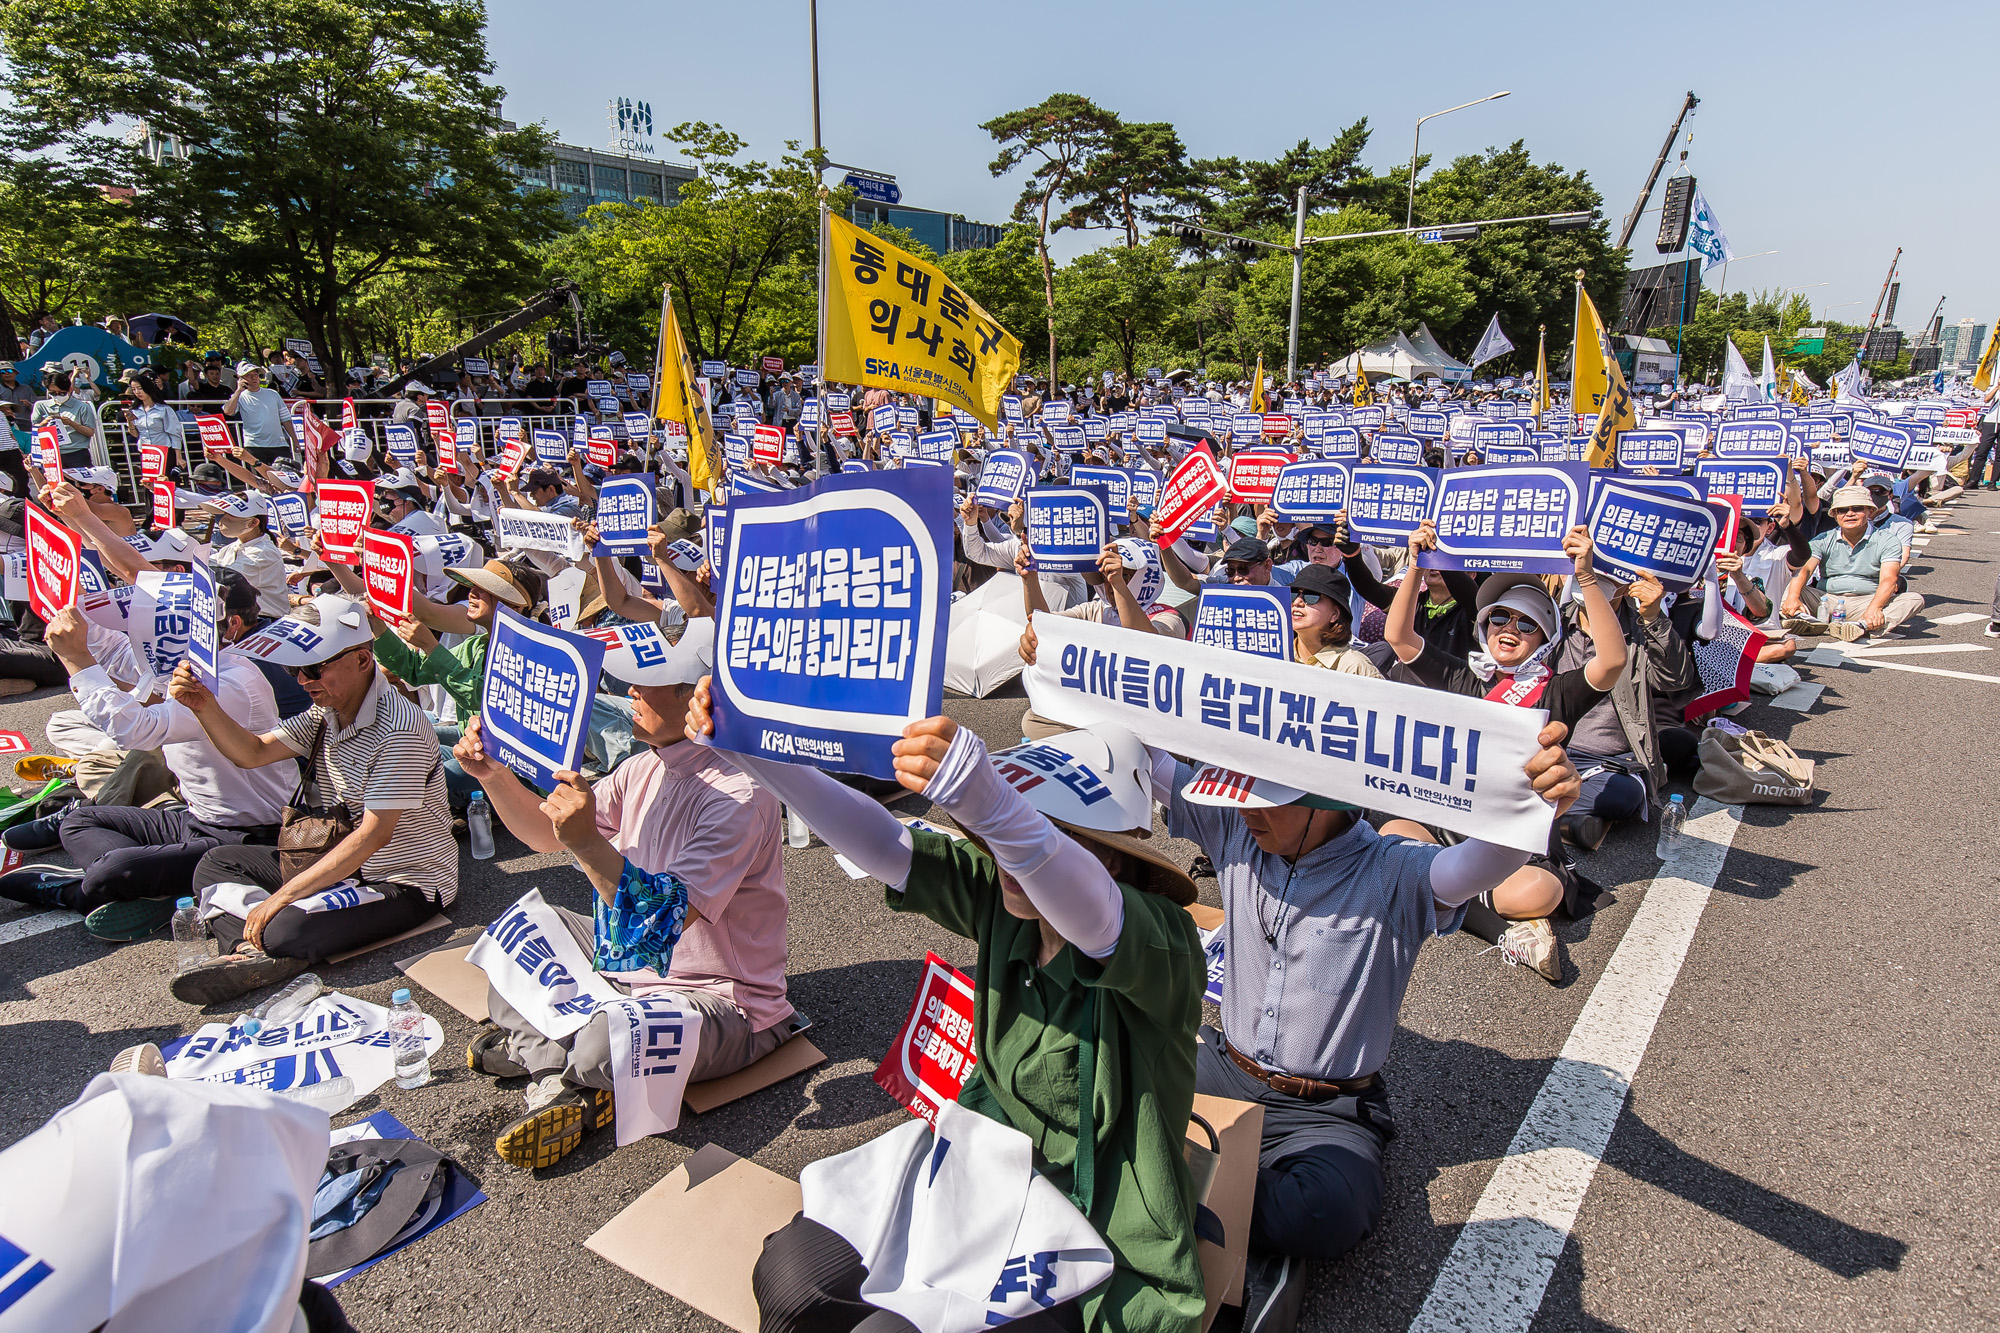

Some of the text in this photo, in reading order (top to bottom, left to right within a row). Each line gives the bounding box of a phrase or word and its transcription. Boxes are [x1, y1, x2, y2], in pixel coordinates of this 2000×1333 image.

[619, 138, 655, 154] CCMM
[858, 179, 886, 193] 여의대로
[890, 190, 898, 199] 99
[869, 299, 976, 384] 의사회
[865, 357, 900, 380] SMA
[1410, 416, 1444, 425] 의료농단 교육농단
[1410, 423, 1444, 432] 필수의료 붕괴된다
[1479, 430, 1520, 440] 의료농단 교육농단
[1622, 439, 1677, 451] 의료농단 교육농단
[1722, 429, 1782, 441] 의료농단 교육농단
[1854, 429, 1906, 449] 의료농단 교육농단
[1934, 430, 1974, 440] 리겠습니다!
[1380, 451, 1418, 461] 필수의료 붕괴된다
[1381, 443, 1419, 452] 의료농단 교육농단
[1621, 450, 1677, 461] 필수의료 붕괴된다
[1720, 440, 1781, 452] 필수의료 붕괴된다
[1852, 440, 1902, 460] 필수의료 붕괴된다
[1176, 460, 1206, 490] 정책추진
[1236, 465, 1281, 475] 일방적인 정책추
[1738, 471, 1776, 486] 교육농단
[1181, 471, 1212, 500] 위험한다
[1234, 476, 1278, 487] 국민건강 위험한
[1281, 474, 1344, 489] 의료농단 교육농단
[599, 493, 646, 512] 의료농단 교육농단
[1278, 489, 1343, 504] 필수의료 붕괴된다
[1353, 482, 1428, 504] 의료농단 교육농단
[1442, 488, 1567, 513] 의료농단 교육농단
[1738, 486, 1776, 499] 붕괴된다
[338, 501, 365, 518] 정책추진
[1030, 505, 1097, 525] 의료농단 교육농단
[1351, 501, 1425, 522] 필수의료 붕괴된다
[338, 519, 360, 536] 위험한다
[502, 516, 569, 543] 의사들이 살리겠습니다!
[599, 513, 646, 532] 필수의료 붕괴된다
[1439, 514, 1565, 539] 필수의료 붕괴된다
[1601, 504, 1710, 546] 의료농단 교육농단
[1030, 527, 1098, 546] 필수의료 붕괴된다
[1595, 524, 1702, 568] 필수의료 붕괴된다
[47, 548, 72, 581] 수요조사
[379, 557, 406, 576] 수요조사
[1038, 562, 1052, 570] KMA
[1464, 559, 1490, 569] KMA
[369, 571, 397, 596] 즉각 폐기하라
[735, 545, 915, 610] 의료농단 교육농단
[1613, 568, 1637, 582] KMA
[1199, 605, 1279, 631] 의료농단 교육농단
[622, 623, 667, 669] 붕괴
[730, 615, 913, 683] 필수의료 붕괴된다
[1196, 627, 1281, 655] 필수의료 붕괴된다
[494, 641, 577, 707] 의료농단 교육농단
[488, 676, 569, 746] 필수의료 붕괴된다
[1060, 643, 1482, 794] 의사들이 살리겠습니다!
[760, 729, 796, 755] KMA
[794, 736, 844, 756] 대한의사협회
[499, 746, 517, 767] KMA
[1191, 767, 1256, 803] 저지
[1364, 773, 1412, 798] KMA
[1753, 782, 1805, 799] maram
[1413, 786, 1472, 809] 대한의사협회
[618, 1002, 640, 1030] KMA
[925, 995, 973, 1050] 의대정원
[171, 1003, 361, 1060] 리겠습니다!
[294, 1035, 332, 1048] KMA
[913, 1024, 965, 1080] 의료체계
[910, 1096, 934, 1122] KMA
